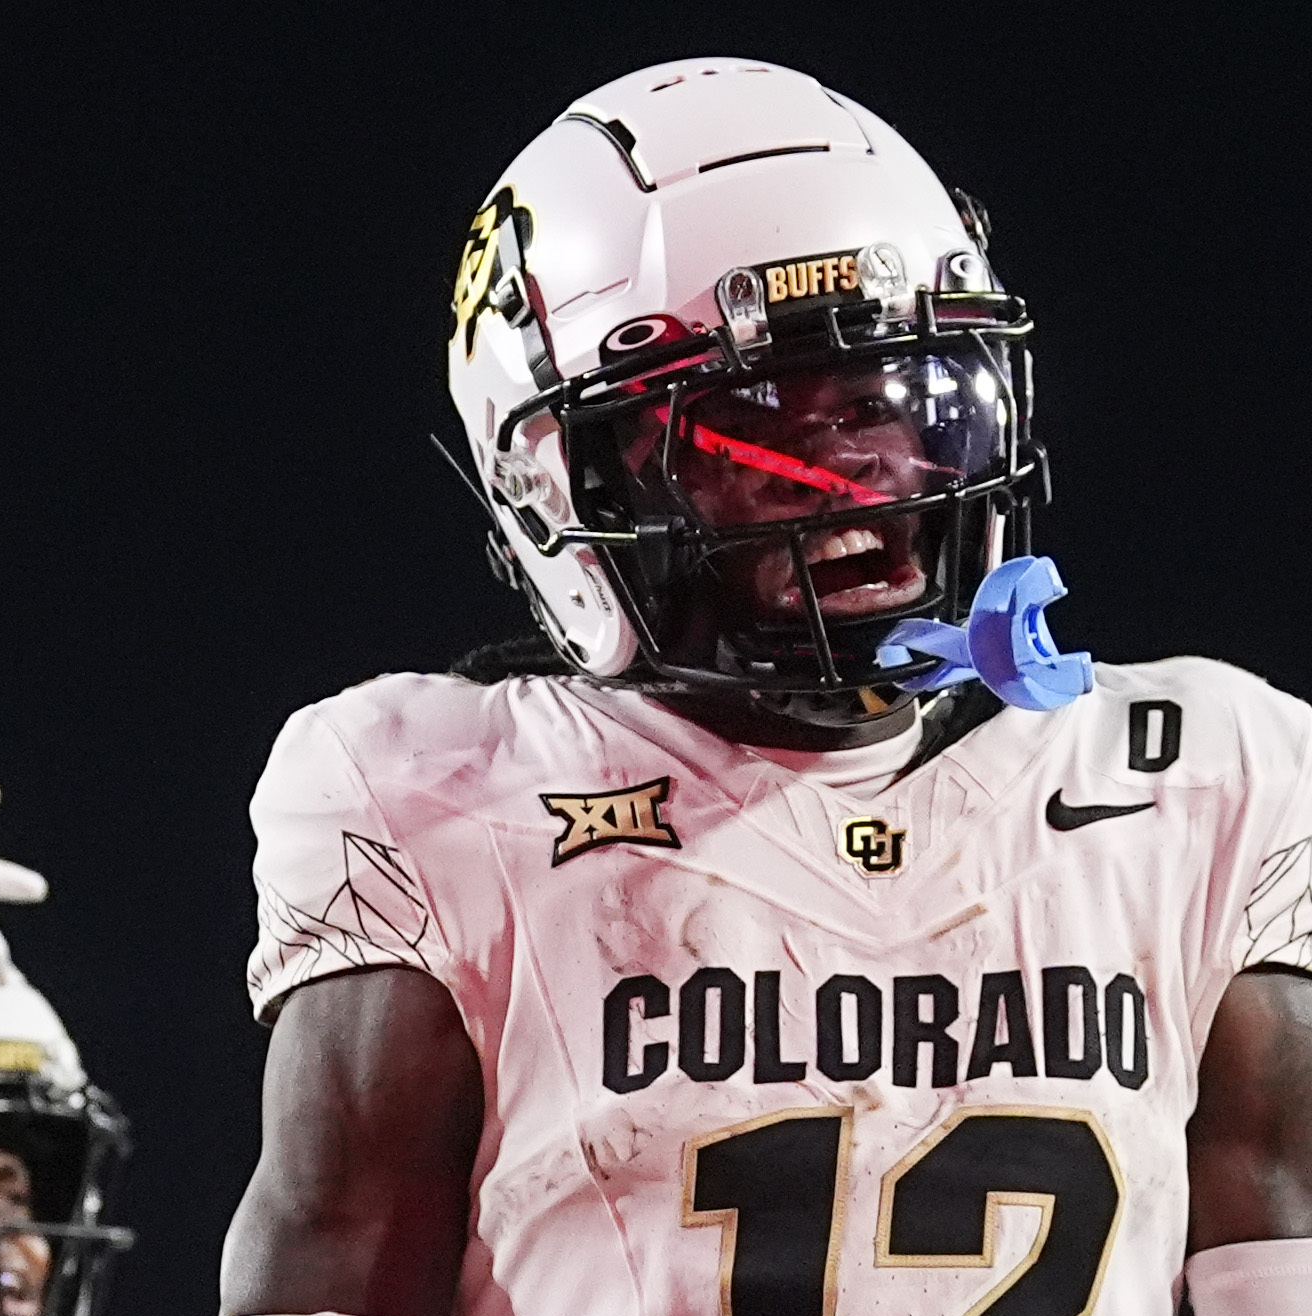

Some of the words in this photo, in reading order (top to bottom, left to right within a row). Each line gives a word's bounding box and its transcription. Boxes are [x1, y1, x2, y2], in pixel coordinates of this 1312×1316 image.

[765, 255, 860, 304] BUFFS
[1128, 699, 1183, 774] D
[845, 819, 906, 872] CU
[602, 966, 1150, 1095] COLORADO
